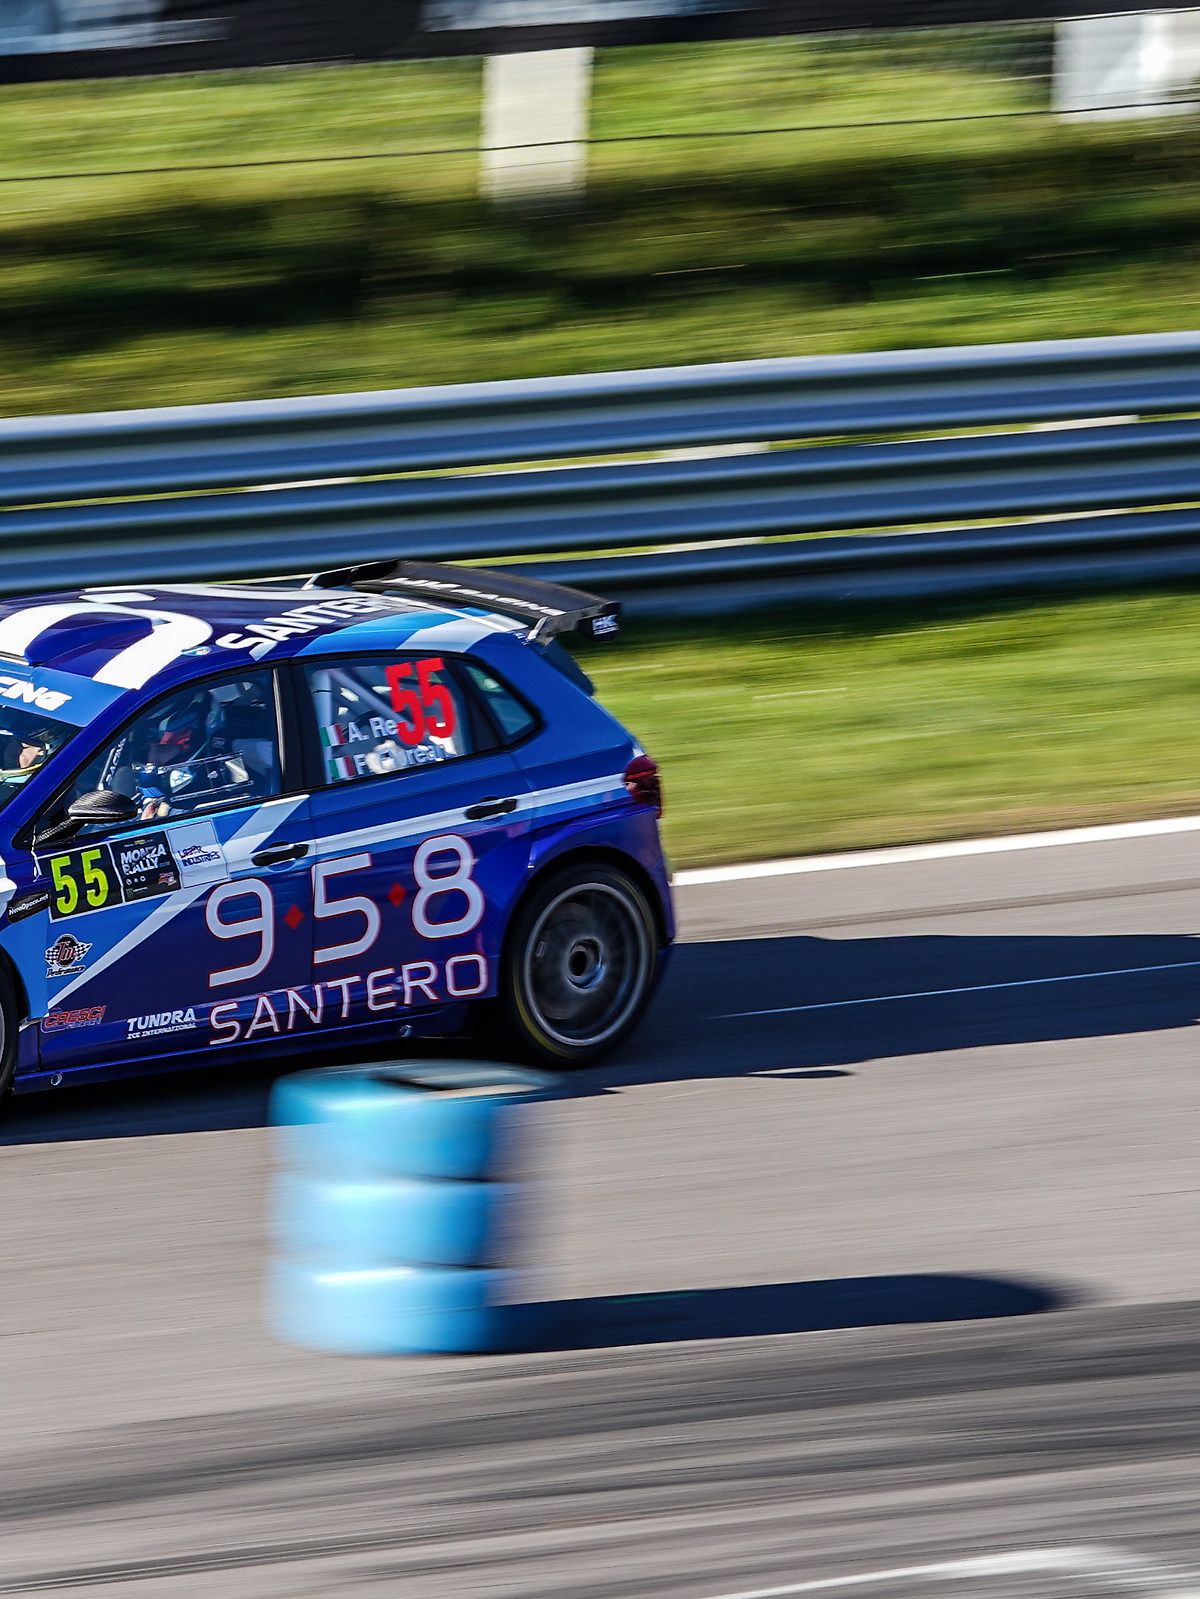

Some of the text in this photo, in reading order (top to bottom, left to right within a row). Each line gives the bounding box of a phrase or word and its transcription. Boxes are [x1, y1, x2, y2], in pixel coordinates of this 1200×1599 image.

[385, 657, 457, 745] 55
[50, 848, 109, 914] 55
[122, 856, 159, 876] RALLY
[126, 1007, 197, 1032] TUNDRA
[209, 953, 489, 1046] SANTERO
